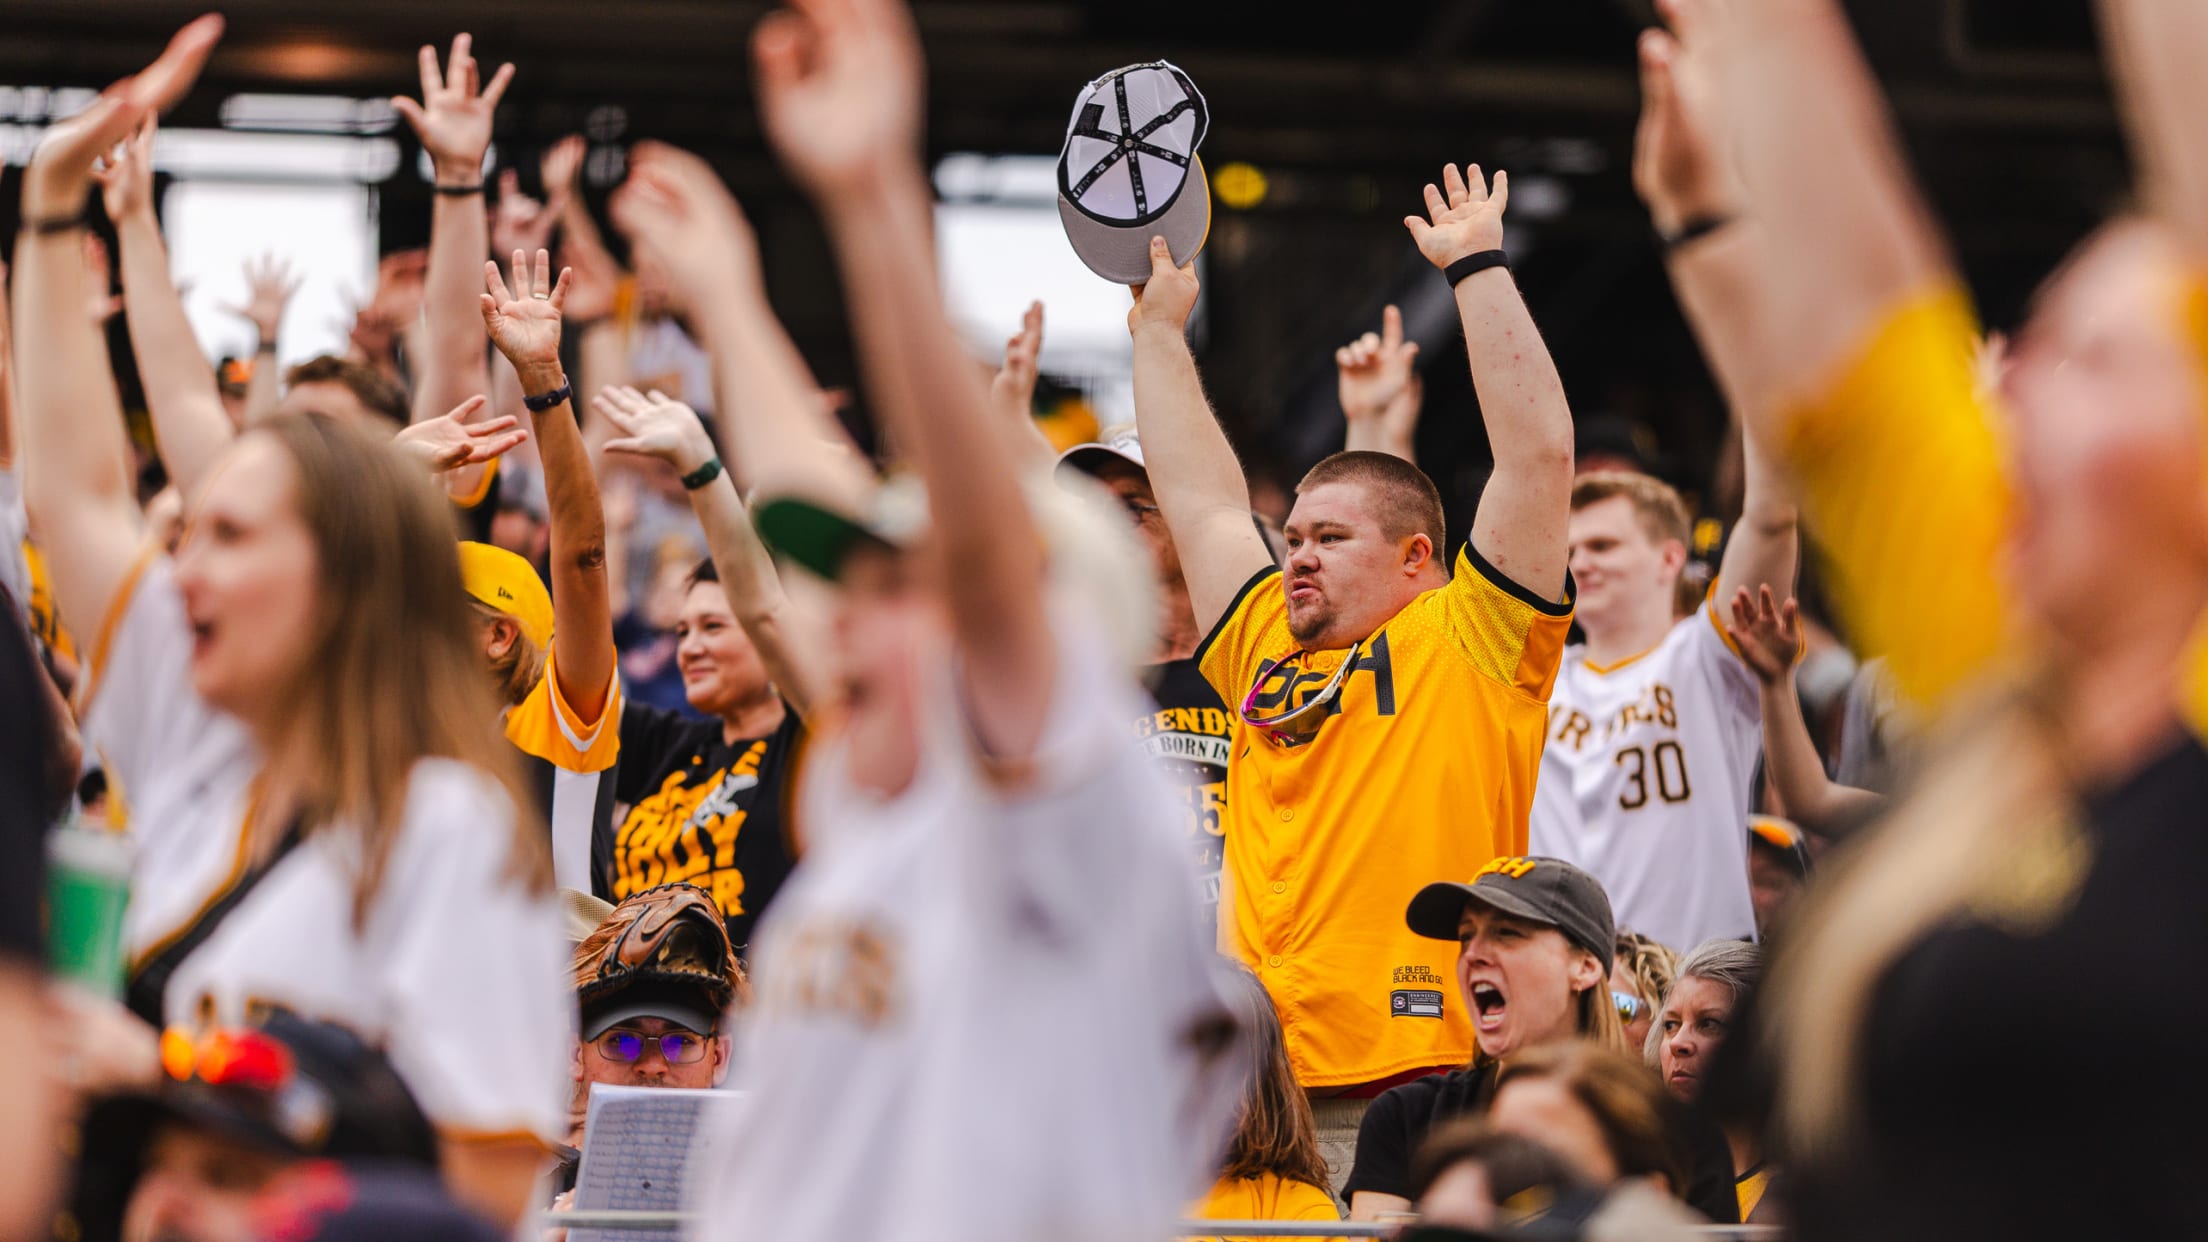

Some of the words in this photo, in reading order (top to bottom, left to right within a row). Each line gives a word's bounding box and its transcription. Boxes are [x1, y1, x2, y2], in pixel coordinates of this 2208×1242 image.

[1160, 736, 1208, 758] BORN
[1616, 741, 1691, 810] 30
[1405, 966, 1430, 975] BLEED
[1393, 975, 1418, 984] BLACK
[1419, 974, 1435, 983] AND
